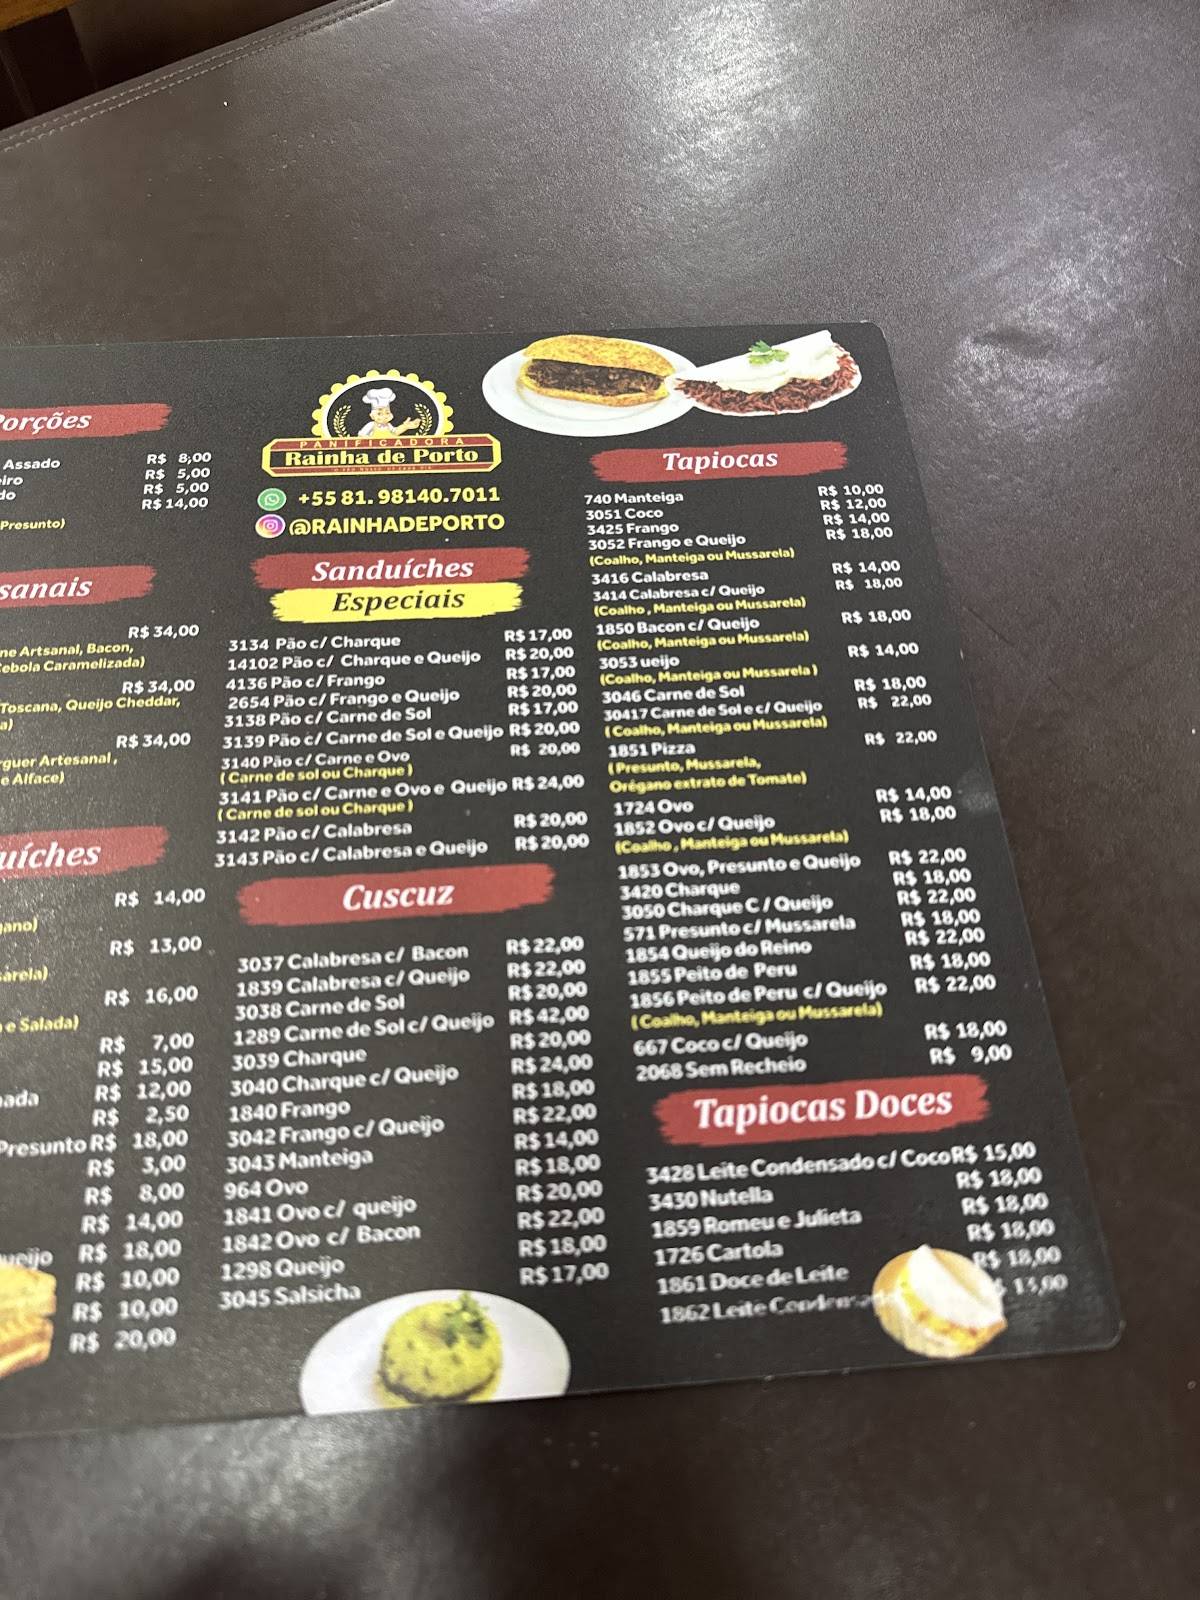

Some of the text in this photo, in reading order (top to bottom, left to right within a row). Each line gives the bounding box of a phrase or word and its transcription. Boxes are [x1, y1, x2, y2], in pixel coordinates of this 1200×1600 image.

[299, 437, 465, 450] PANIFICADORA
[3, 458, 60, 470] Assado
[284, 448, 479, 467] Rainha de Porto
[663, 451, 778, 474] Tapiocas
[145, 467, 210, 480] R$ 5,00
[299, 491, 336, 506] +55
[378, 487, 500, 504] 98140.7011
[584, 492, 684, 505] 740 Manteiga
[818, 484, 884, 497] R$ 10,00
[142, 497, 208, 510] R$ 14,00
[820, 497, 887, 511] R$ 12,00
[289, 513, 505, 535] @RAINHADEPORTO
[586, 508, 664, 520] 3051 Coco
[823, 512, 890, 526] R$ 14,00
[587, 523, 679, 535] 3425 Frango
[311, 558, 474, 581] Sanduíches
[592, 570, 709, 585] 3416 Calabresa
[832, 560, 900, 575] R$ 14,00
[332, 589, 465, 616] Especiais
[596, 617, 760, 635] 1850 Bacon c/ Queijo
[841, 609, 911, 624] R$ 18,00
[128, 624, 199, 639] R$ 34,00
[504, 628, 573, 643] R$ 17,00
[87, 643, 133, 654] Bacon,
[229, 636, 401, 652] 3134 Pão c/ Charque
[43, 656, 145, 671] Caramelizada)
[599, 656, 638, 670] 3053
[226, 674, 385, 690] 4136 Pão c/ Frango
[66, 698, 113, 712] Queijo
[116, 695, 180, 708] Cheddar,
[602, 685, 745, 704] 3046 Carne de Sol
[864, 730, 937, 746] R$ 22,00
[512, 774, 585, 791] R$ 24,00
[614, 799, 694, 816] 1724 Ovo
[514, 811, 588, 829] R$ 20,00
[216, 822, 412, 844] 3142 Pão c/ Calabresa
[114, 888, 205, 908] R$ 14,00
[343, 885, 454, 911] Cuscuz
[621, 882, 740, 900] 3420 Charque
[110, 936, 202, 957] R$ 13,00
[506, 936, 584, 955] R$ 22,00
[626, 939, 812, 963] 1854 Queijo do Reino
[238, 945, 469, 973] 3037 Calabresa c/ Bacon
[235, 993, 405, 1021] 3038 Carne de Sol
[509, 1005, 589, 1025] R$ 42,00
[19, 1015, 79, 1033] Salada)
[924, 1020, 1007, 1040] R$ 18,00
[100, 1033, 194, 1055] R$ 7,00
[633, 1031, 808, 1056] 667 Coco c/ Queijo
[929, 1044, 1012, 1065] R$ 9,00
[637, 1056, 807, 1081] 2068 Sem Recheio
[92, 1104, 189, 1128] R$ 2,50
[230, 1101, 351, 1122] 1840 Frango
[694, 1090, 952, 1135] Tapiocas Doces
[90, 1129, 188, 1153] R$ 18,00
[226, 1150, 373, 1174] 3043 Manteiga
[85, 1182, 184, 1206] R$ 8,00
[224, 1179, 309, 1200] 964 Ovo
[649, 1186, 774, 1211] 3430 Nutella
[652, 1208, 862, 1238] 1859 Romeu e Julieta
[967, 1218, 1055, 1242] R$ 18,00
[223, 1225, 421, 1253] 1842 Ovo c/ Bacon
[654, 1240, 784, 1266] 1726 Cartola
[520, 1262, 609, 1285] R$ 17,00
[657, 1265, 849, 1295] 1861 Doce de Leite
[219, 1283, 361, 1310] 3045 Salsicha
[70, 1327, 176, 1353] R$ 20,00
